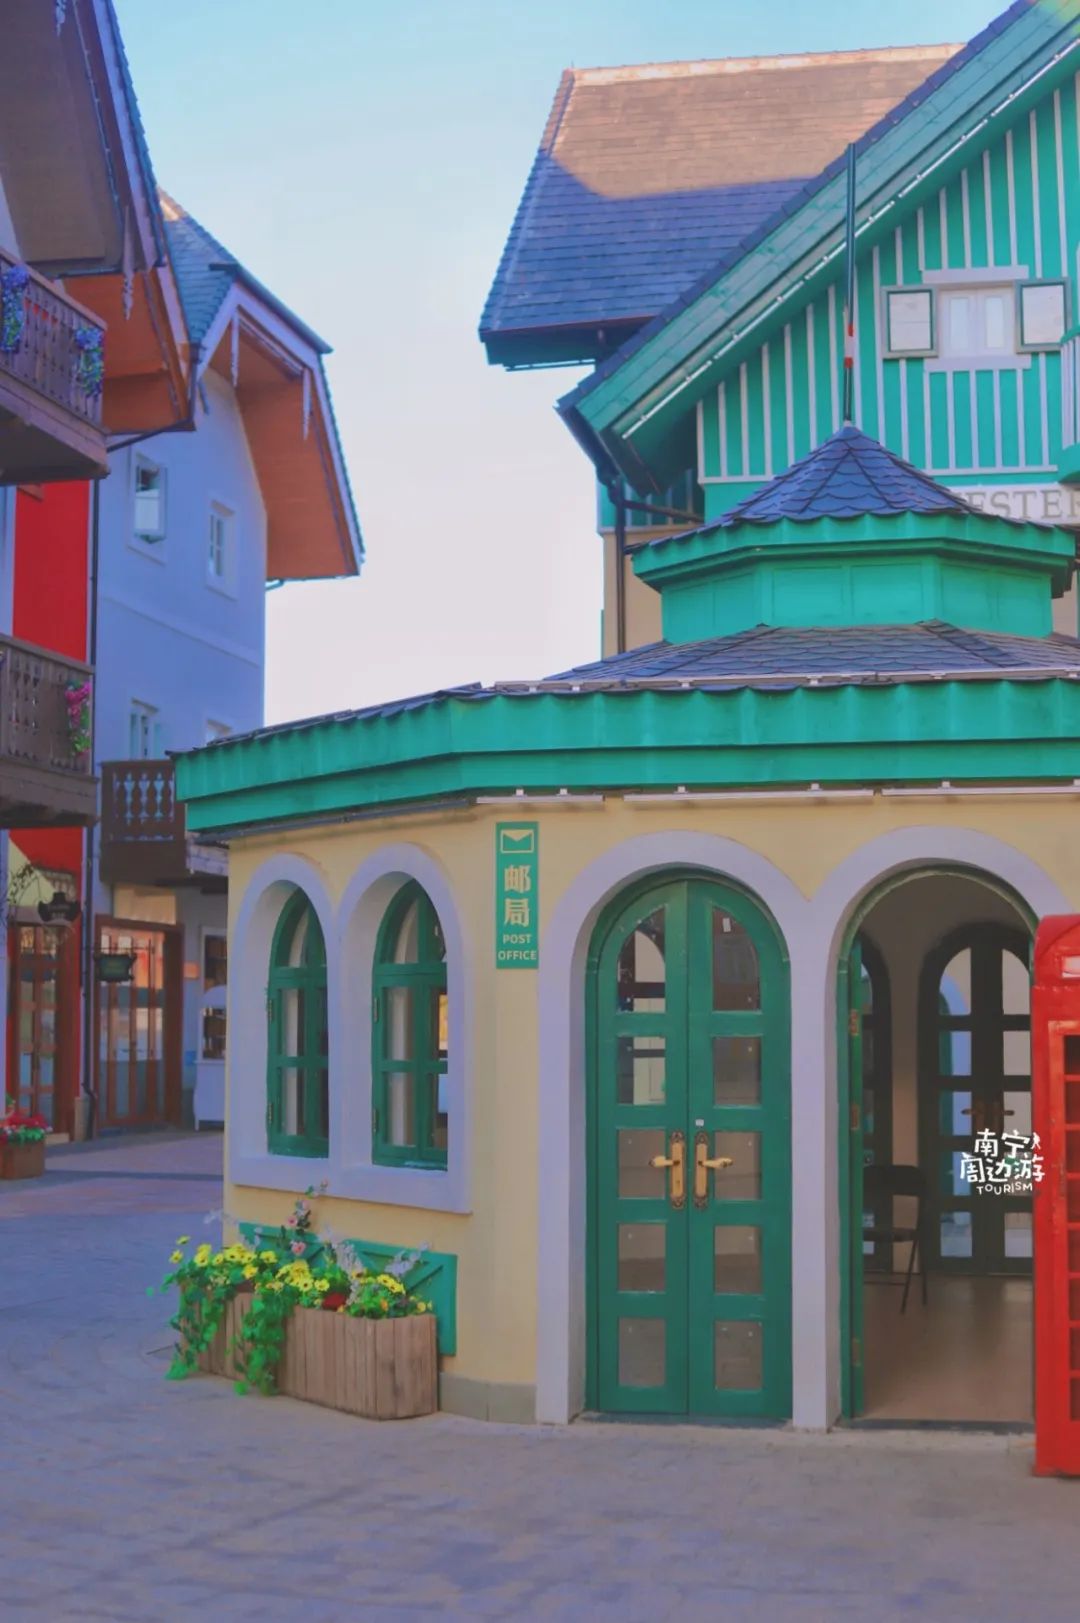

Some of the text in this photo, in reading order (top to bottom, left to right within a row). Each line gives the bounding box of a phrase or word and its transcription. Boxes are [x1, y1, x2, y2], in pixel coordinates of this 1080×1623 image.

[504, 865, 531, 927] 邮局
[503, 934, 532, 944] POST
[498, 950, 537, 960] OFFICE
